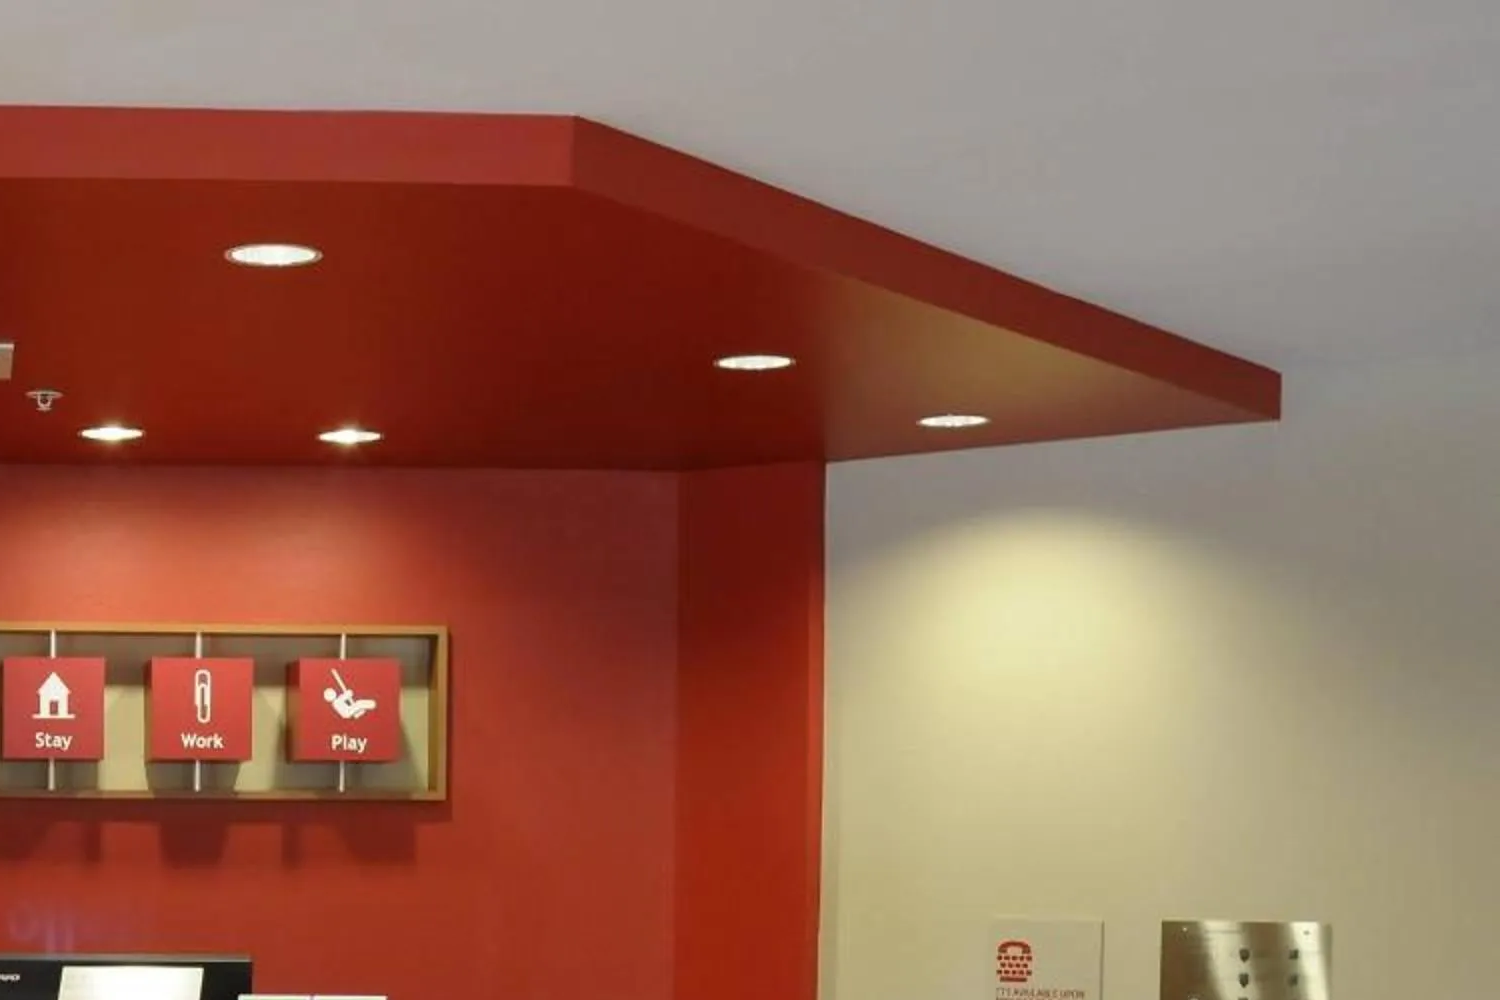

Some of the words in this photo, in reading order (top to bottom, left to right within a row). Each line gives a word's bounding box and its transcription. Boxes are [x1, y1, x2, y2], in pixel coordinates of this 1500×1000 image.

[35, 732, 72, 750] Stay
[181, 733, 224, 749] Work
[331, 735, 367, 751] Play
